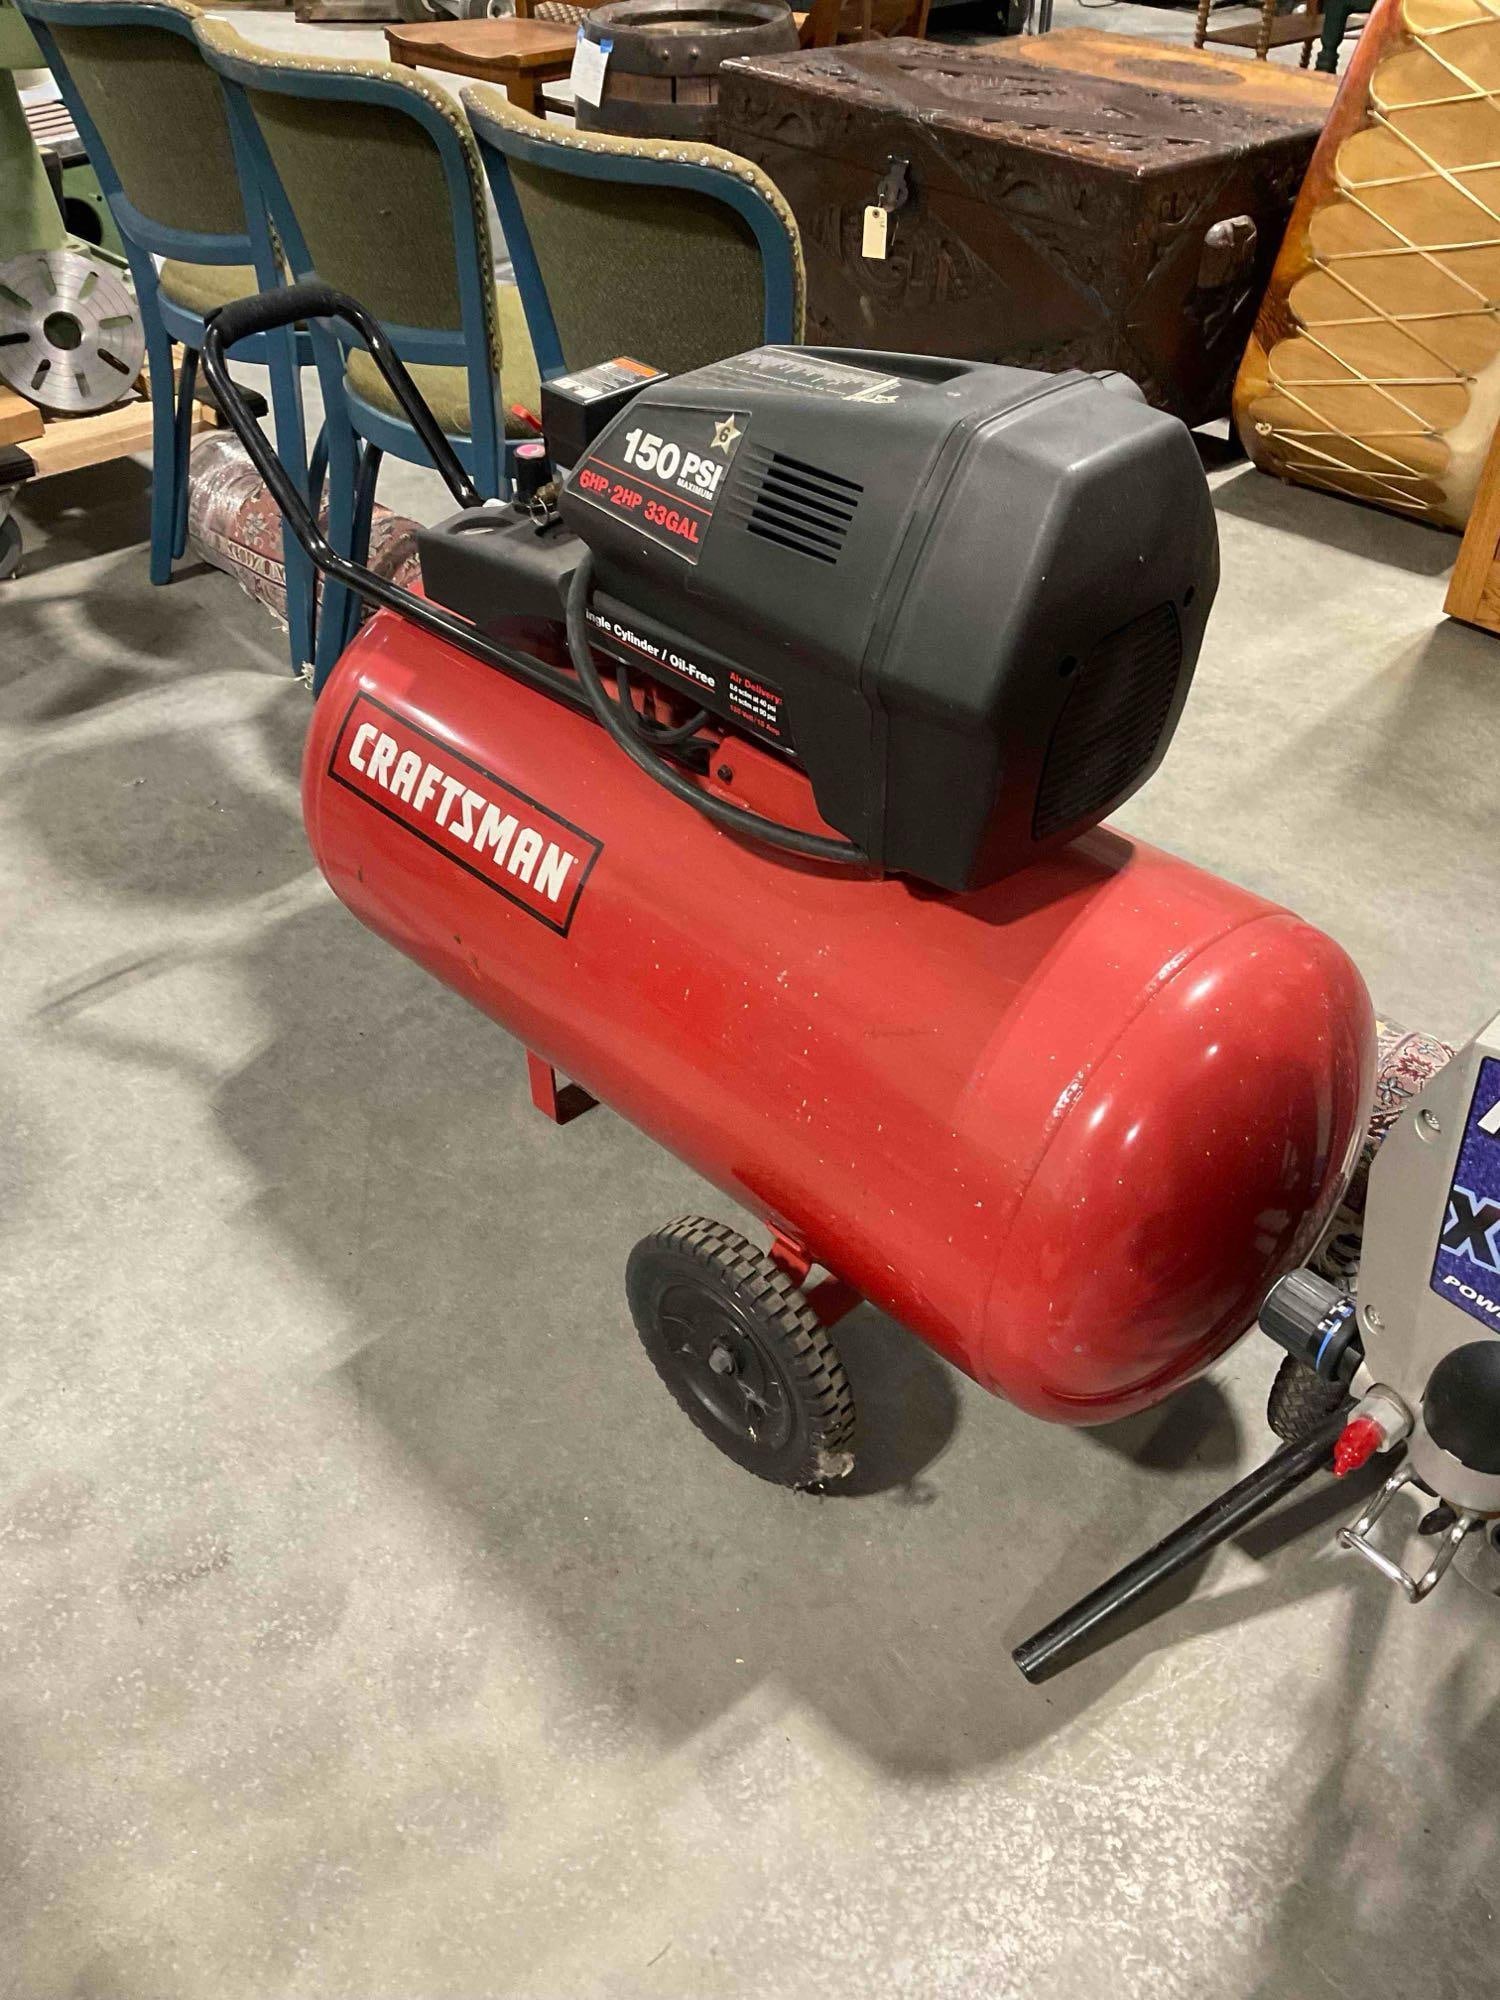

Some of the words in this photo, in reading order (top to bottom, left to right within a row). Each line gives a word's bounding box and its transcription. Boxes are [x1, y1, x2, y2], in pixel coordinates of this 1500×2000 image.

[719, 427, 731, 443] 6
[623, 428, 681, 480] 150
[679, 451, 723, 492] PSI
[676, 477, 714, 501] MAXIMUM
[644, 501, 699, 544] 33GAL
[585, 608, 611, 631] ingle
[613, 623, 660, 657] Cylinder
[661, 649, 667, 661] /
[669, 654, 716, 687] Oil-Free
[729, 672, 742, 684] Air
[348, 722, 575, 903] CRAFTSMAN
[1443, 1275, 1500, 1318] POW
